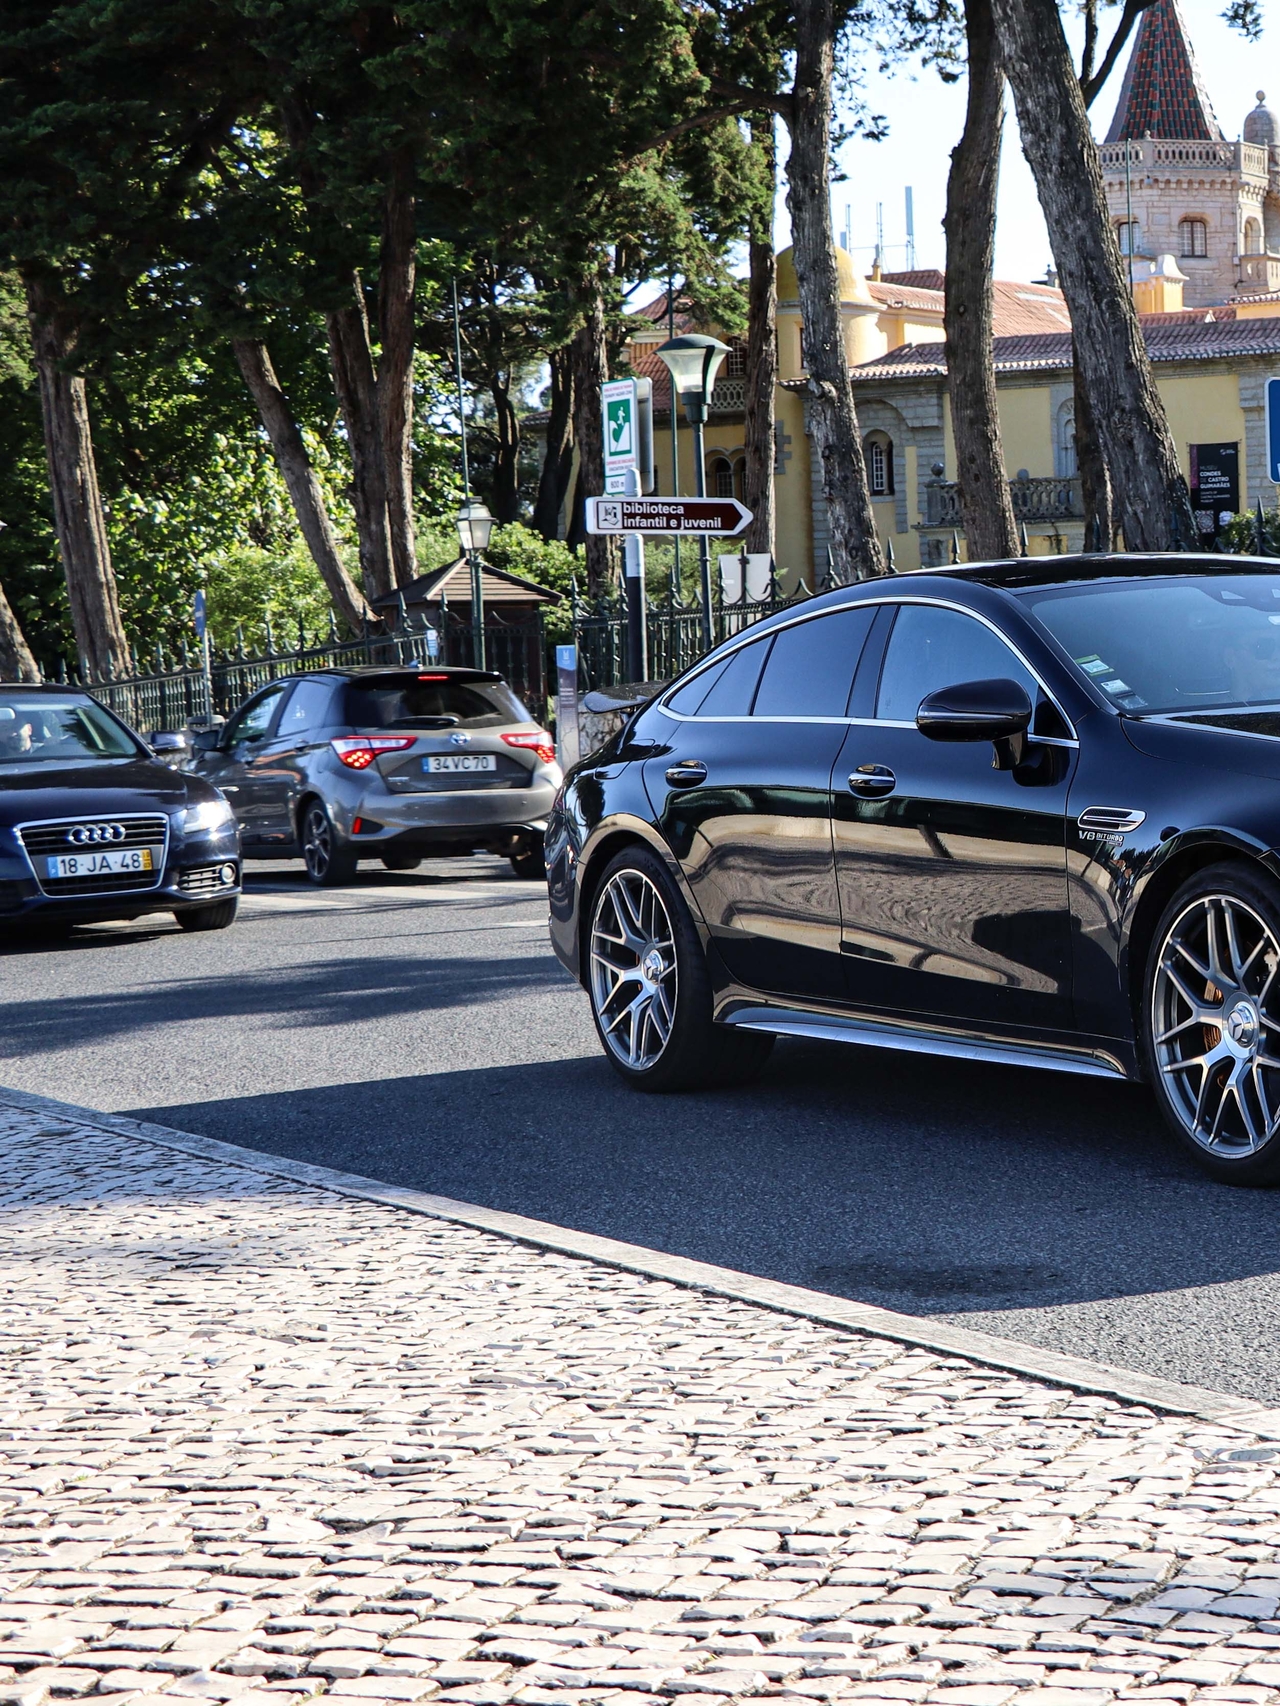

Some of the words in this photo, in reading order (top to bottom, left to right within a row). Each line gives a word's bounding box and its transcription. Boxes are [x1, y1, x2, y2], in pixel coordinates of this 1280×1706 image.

[623, 502, 684, 514] biblioteca
[623, 516, 667, 528] infantil
[669, 520, 678, 528] e
[680, 517, 722, 530] juvenil
[1079, 830, 1096, 840] V8
[1096, 833, 1123, 842] BITURBO
